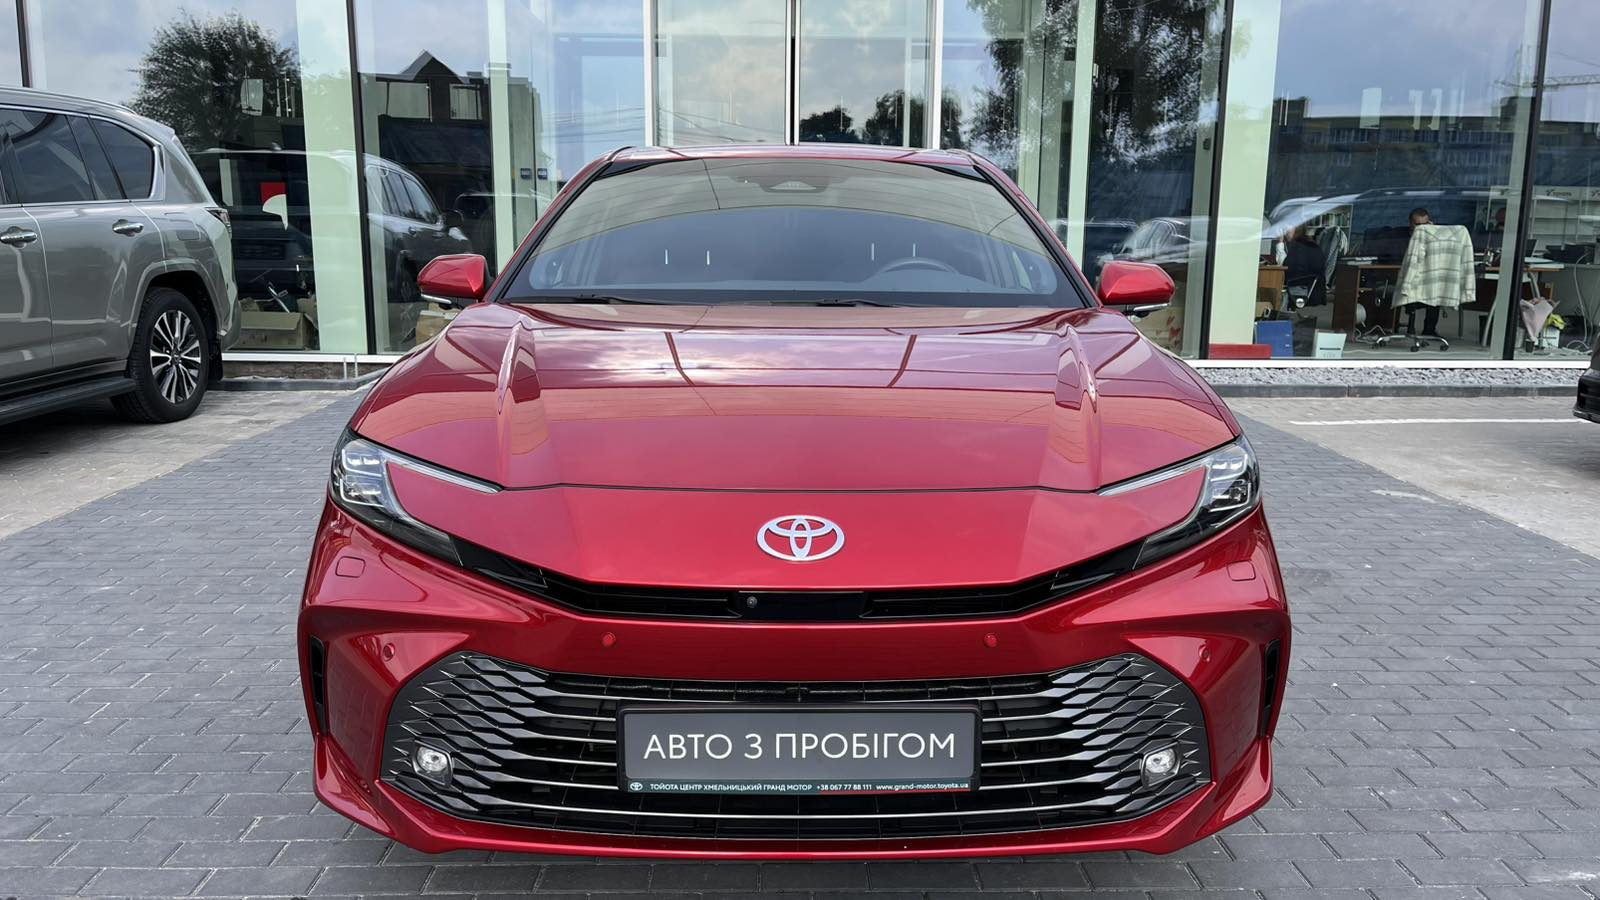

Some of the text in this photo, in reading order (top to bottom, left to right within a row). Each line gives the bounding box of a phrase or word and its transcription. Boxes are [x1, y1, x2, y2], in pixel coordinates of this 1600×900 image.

[644, 732, 955, 760] АВТО З ПРОБІГОМ
[649, 782, 969, 792] ТОЙОТА ЦЕНТР ХМЕЛЬНИЦЬКИЙ ГРАНД МОТОР +38 067 77 88 111 www.grand-motor.toyota.ua
